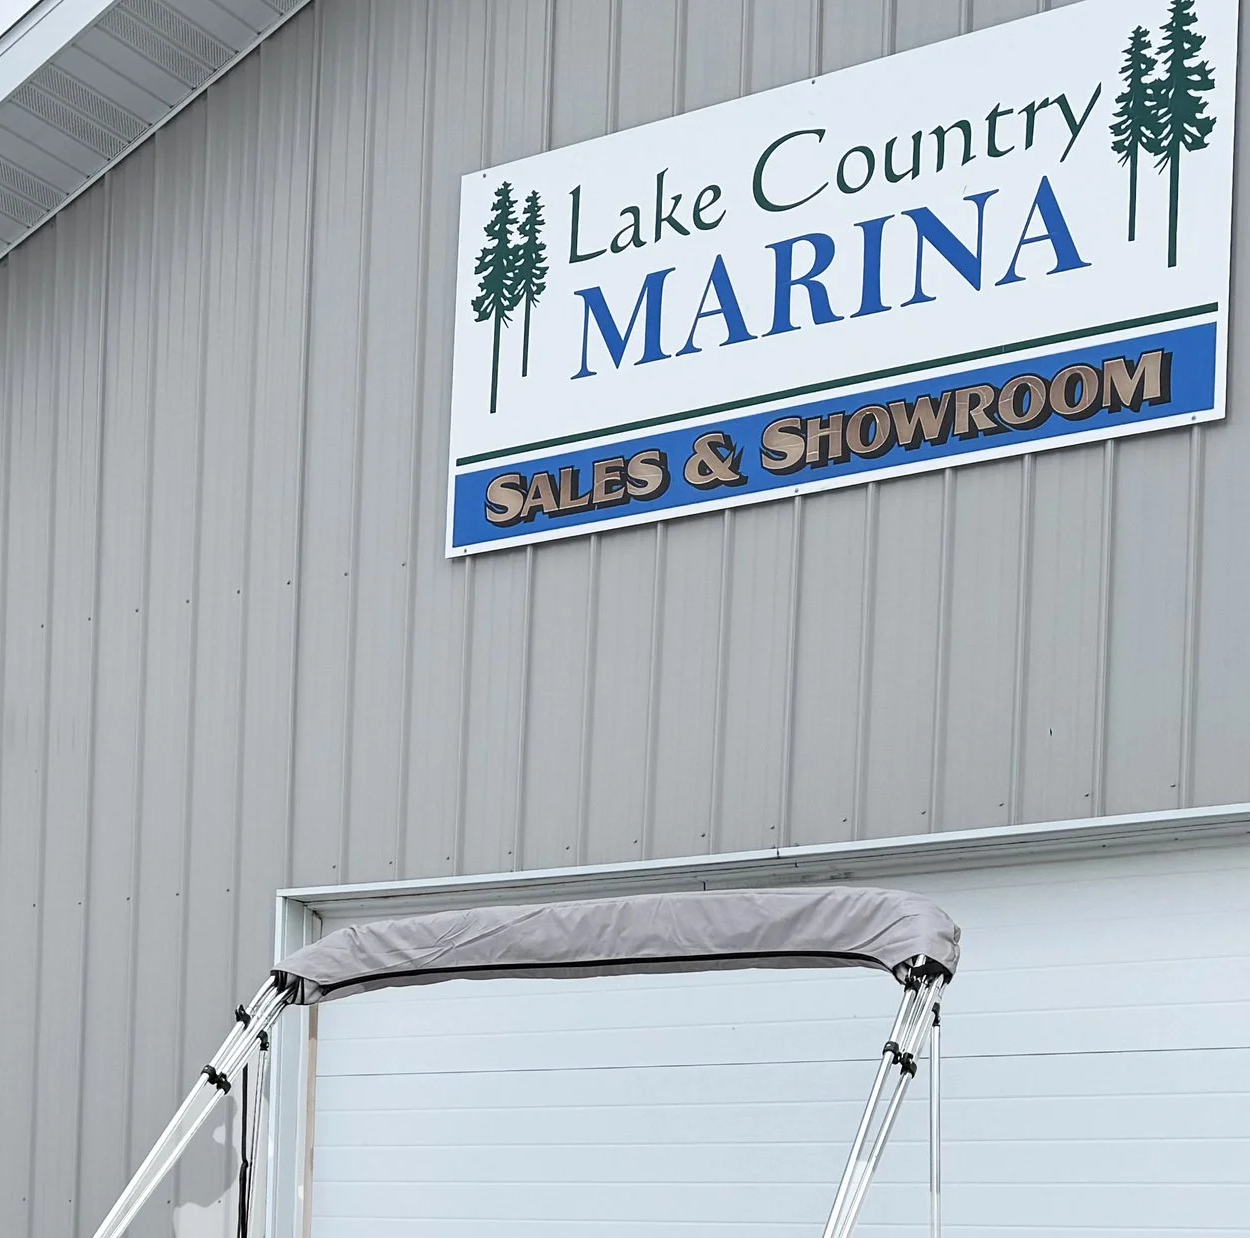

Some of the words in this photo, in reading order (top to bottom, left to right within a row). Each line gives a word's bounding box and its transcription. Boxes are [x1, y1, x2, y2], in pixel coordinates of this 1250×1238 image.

[568, 167, 727, 264] Lake
[752, 82, 1103, 213] Country
[570, 175, 1092, 381] MARINA
[484, 448, 670, 527] SALES
[683, 432, 749, 490] &
[760, 349, 1173, 475] SHOWROOM
